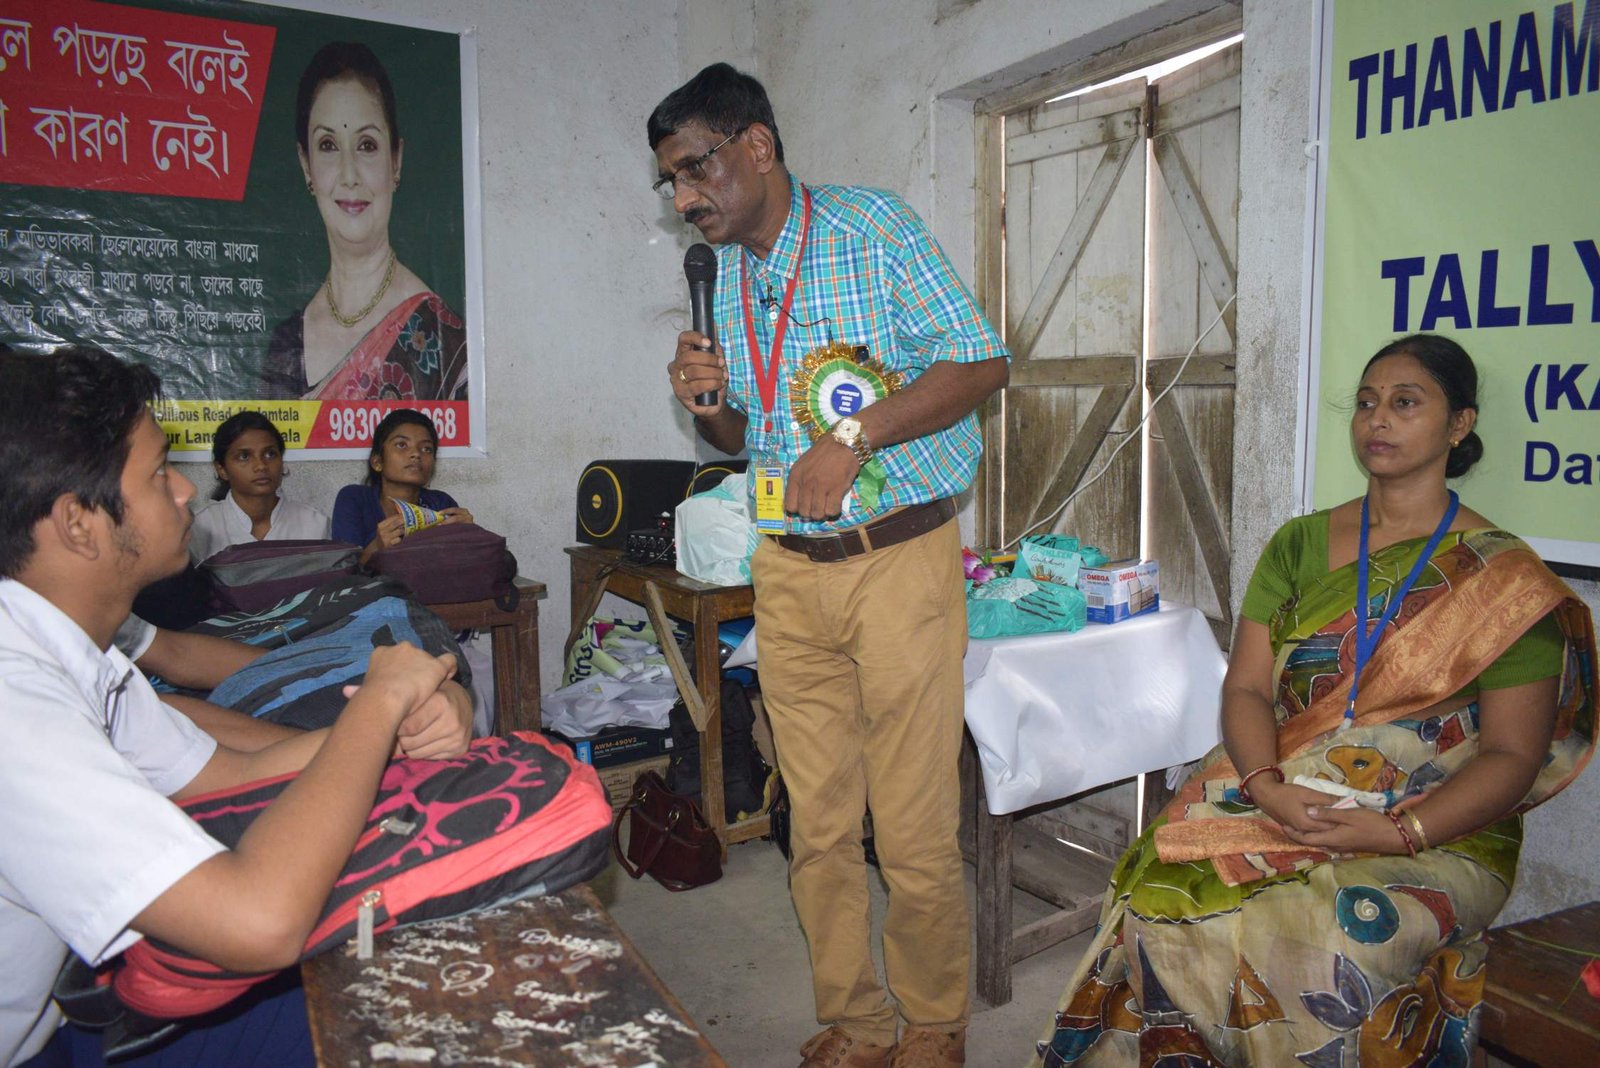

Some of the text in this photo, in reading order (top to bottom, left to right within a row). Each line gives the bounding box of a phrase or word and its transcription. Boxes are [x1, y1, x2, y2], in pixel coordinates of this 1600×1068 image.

[53, 22, 152, 93] পড়ছে
[164, 30, 253, 104] বলেই
[29, 105, 130, 165] কারণ
[16, 224, 94, 254] অভিভাবকরা
[101, 235, 178, 258] ছেলেমেয়েদের
[184, 239, 217, 261] বাংলা
[222, 241, 259, 263] মাধ্যমে
[100, 270, 137, 292] মাধ্যমে
[143, 272, 174, 296] পড়বে
[200, 275, 233, 296] তাদের
[238, 277, 265, 298] কাছে
[329, 407, 457, 441] 983068
[1524, 441, 1600, 485] Da
[1086, 573, 1110, 582] OMEGA
